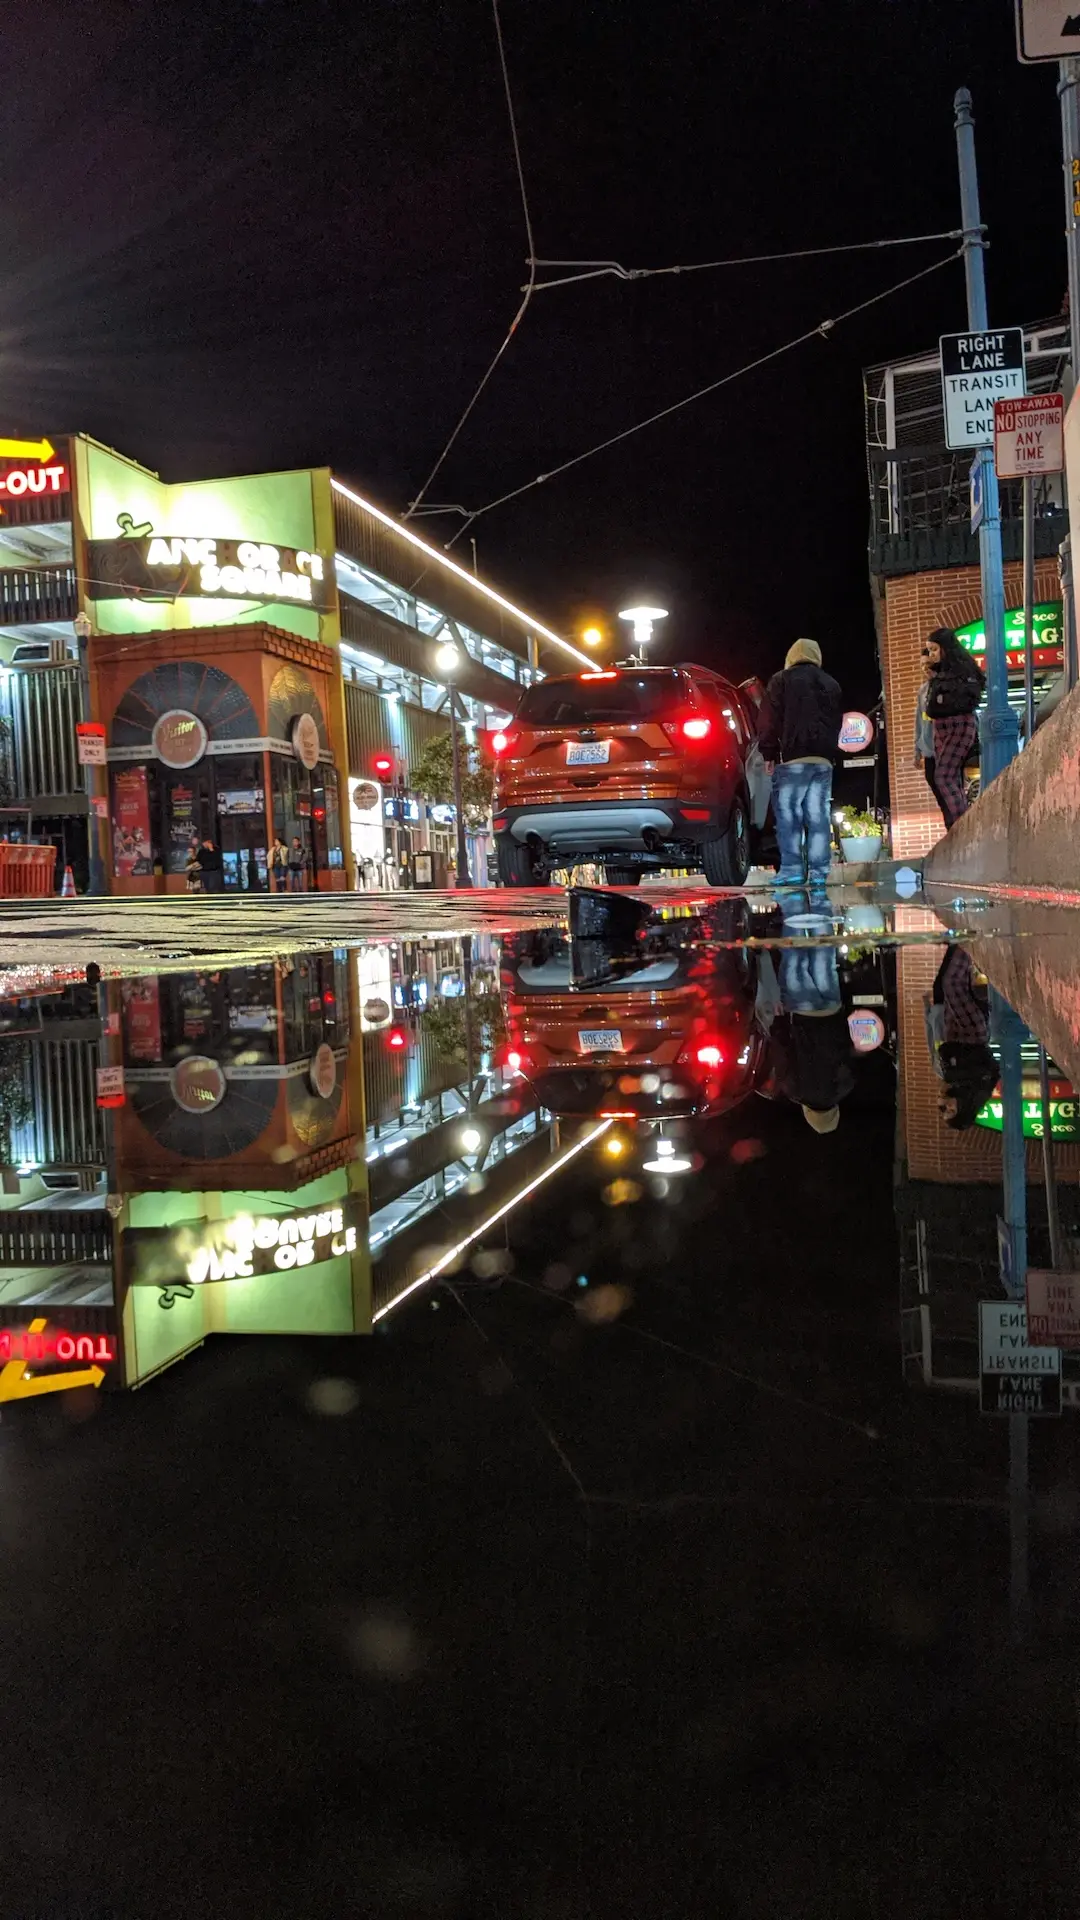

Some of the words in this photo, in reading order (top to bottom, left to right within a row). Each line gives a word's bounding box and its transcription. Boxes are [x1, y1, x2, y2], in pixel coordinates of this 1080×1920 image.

[957, 335, 1005, 354] RIGHT
[960, 353, 1005, 371] LANE
[949, 373, 1018, 393] TRANSIT
[964, 396, 1005, 413] LAN
[1000, 396, 1058, 413] TOW-AWAY
[965, 420, 994, 435] END
[996, 414, 1014, 431] NO
[1016, 411, 1060, 429] STOPPING
[1016, 431, 1042, 446] ANY
[1014, 446, 1045, 462] TIME
[1012, 611, 1058, 626] Snce
